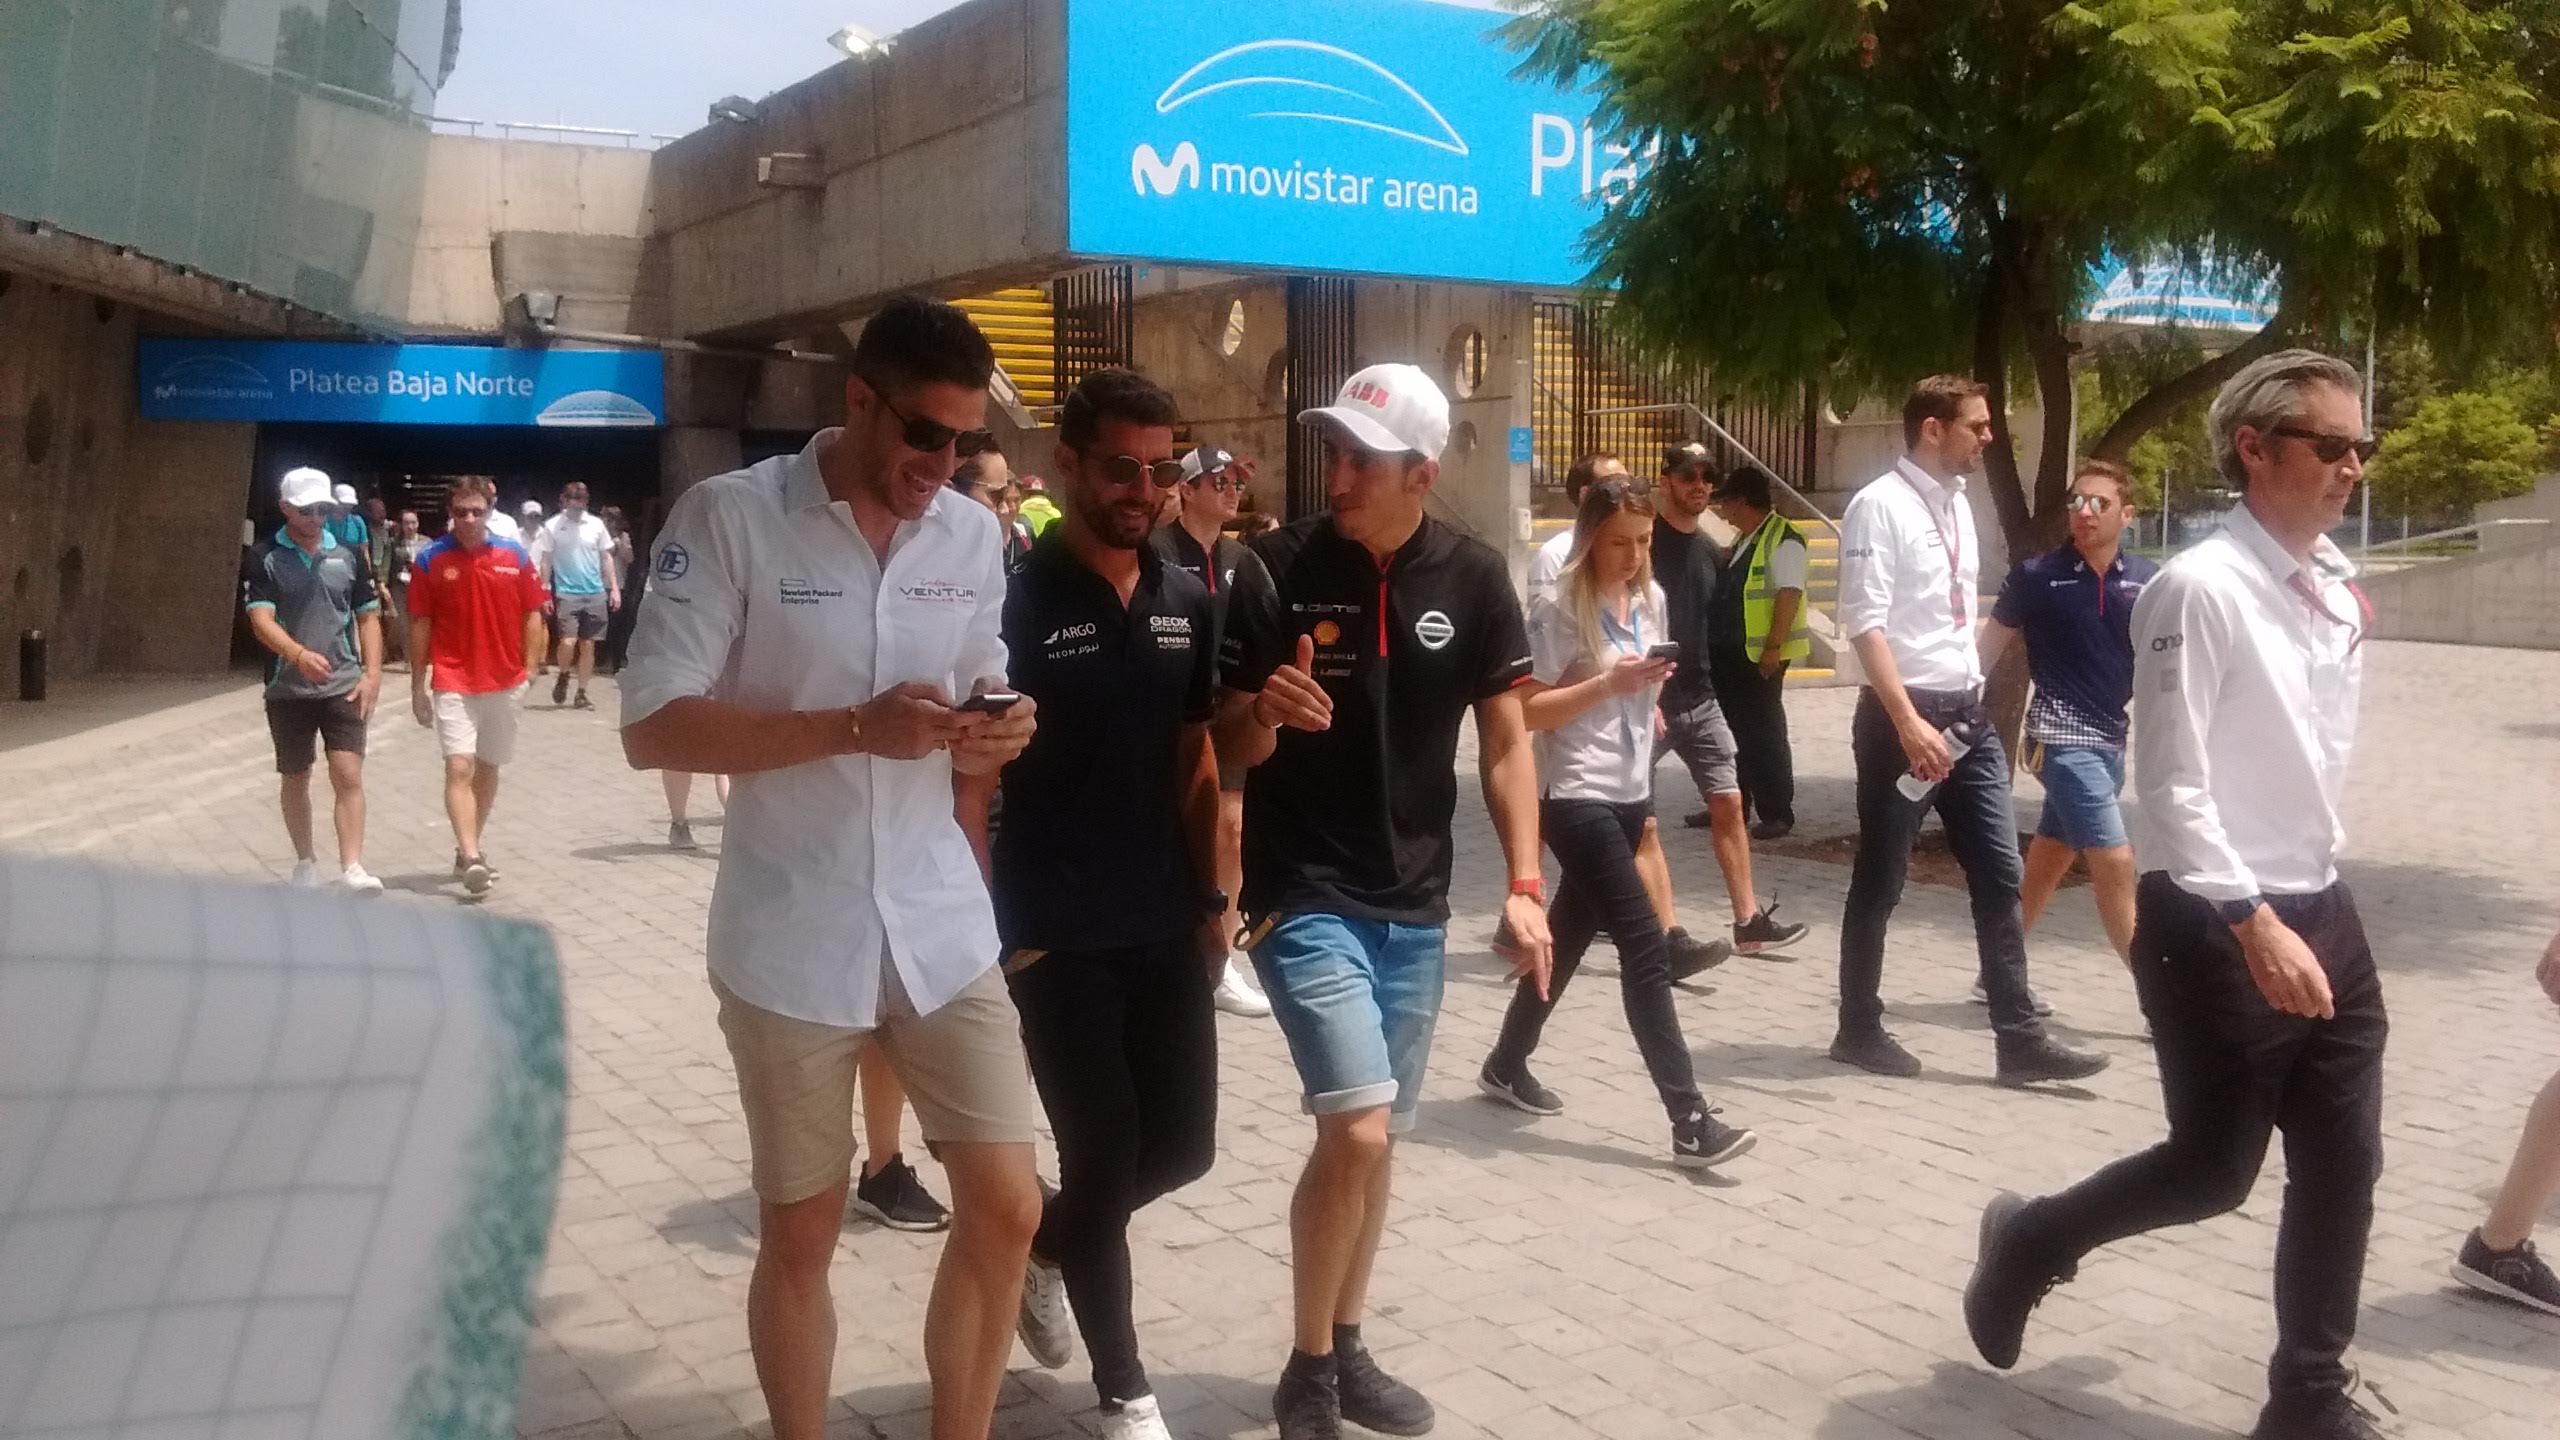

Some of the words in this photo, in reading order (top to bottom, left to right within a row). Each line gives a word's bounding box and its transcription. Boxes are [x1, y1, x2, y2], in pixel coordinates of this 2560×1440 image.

[1211, 160, 1373, 205] movistar
[1383, 177, 1478, 214] arena
[289, 367, 380, 395] Platea
[388, 369, 448, 402] Baja
[455, 371, 534, 396] Norte
[1343, 381, 1390, 408] ABB
[1149, 615, 1191, 627] GEOX
[1150, 625, 1192, 633] DRAGON
[1062, 622, 1097, 640] ARGO
[1157, 636, 1191, 644] PENSKE
